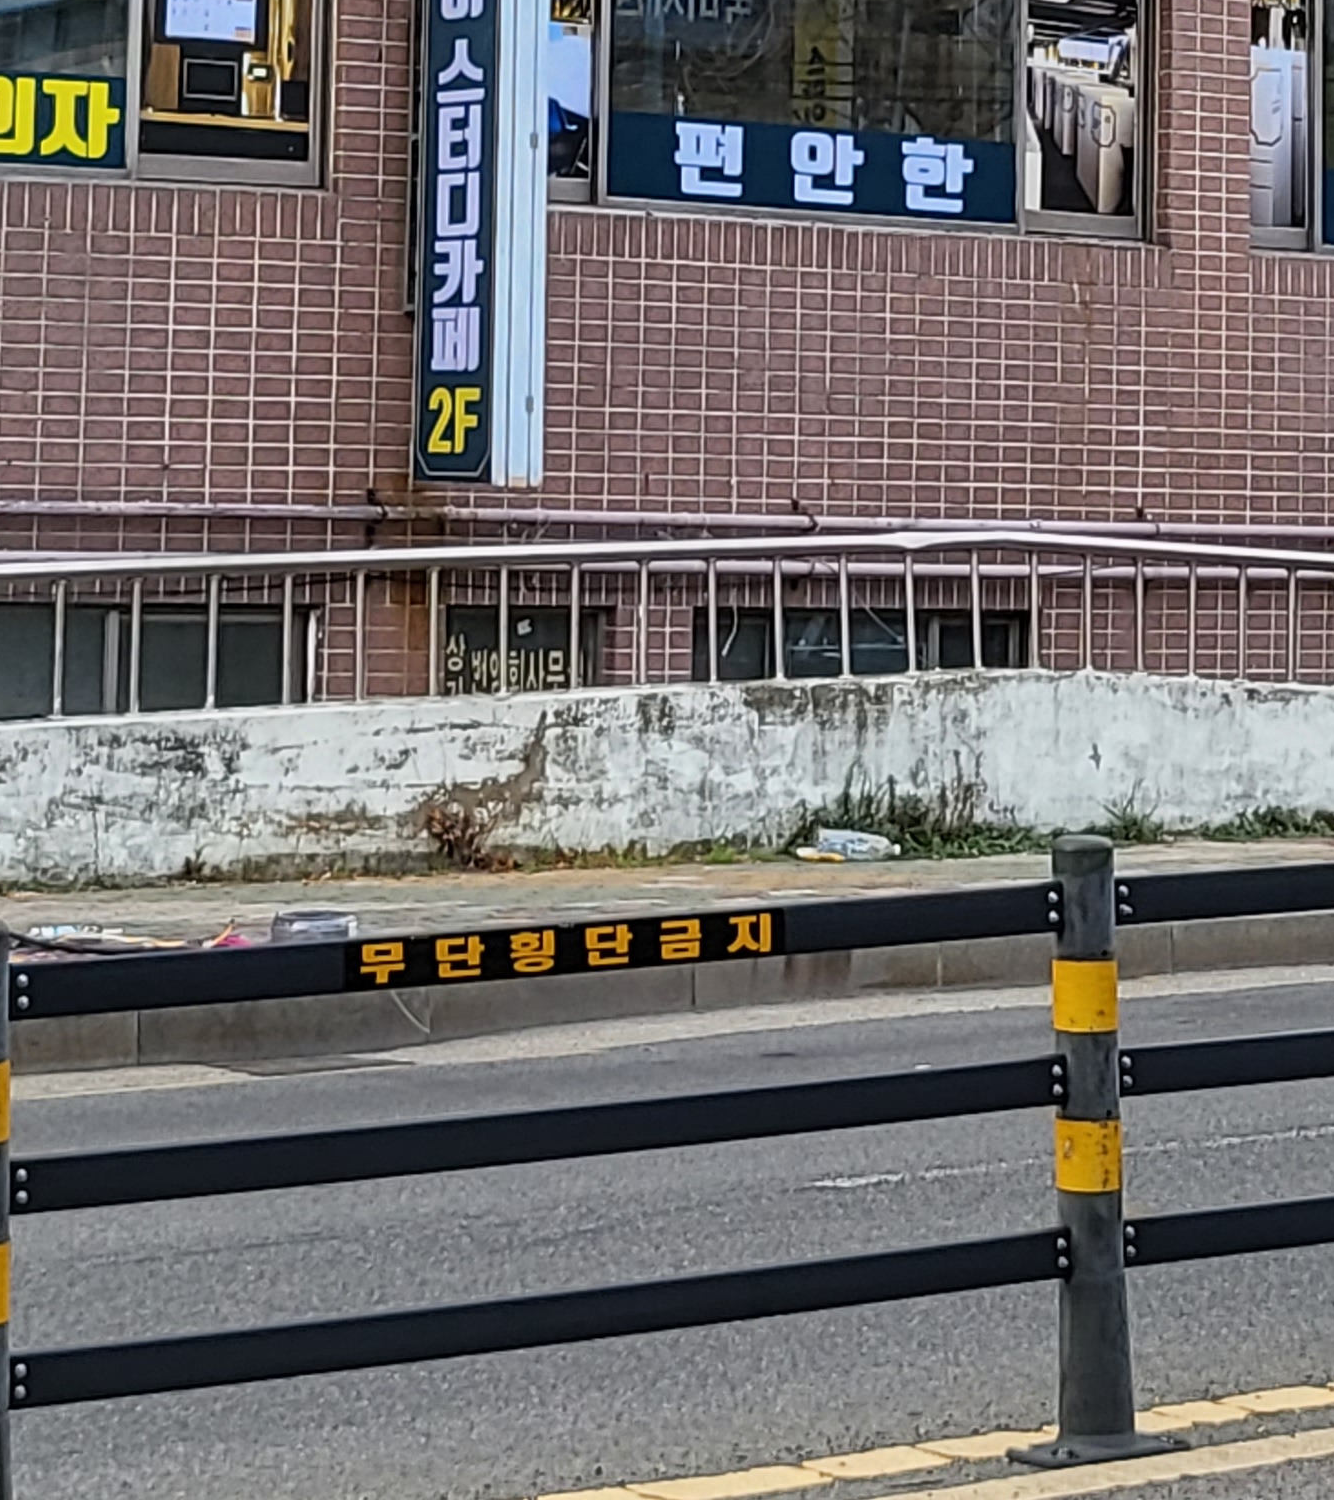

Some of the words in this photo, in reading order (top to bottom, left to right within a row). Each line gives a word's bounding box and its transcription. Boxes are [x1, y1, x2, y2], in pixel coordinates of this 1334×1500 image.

[431, 39, 486, 372] 스터디카페
[674, 121, 973, 213] 편안한
[428, 387, 480, 454] 2F
